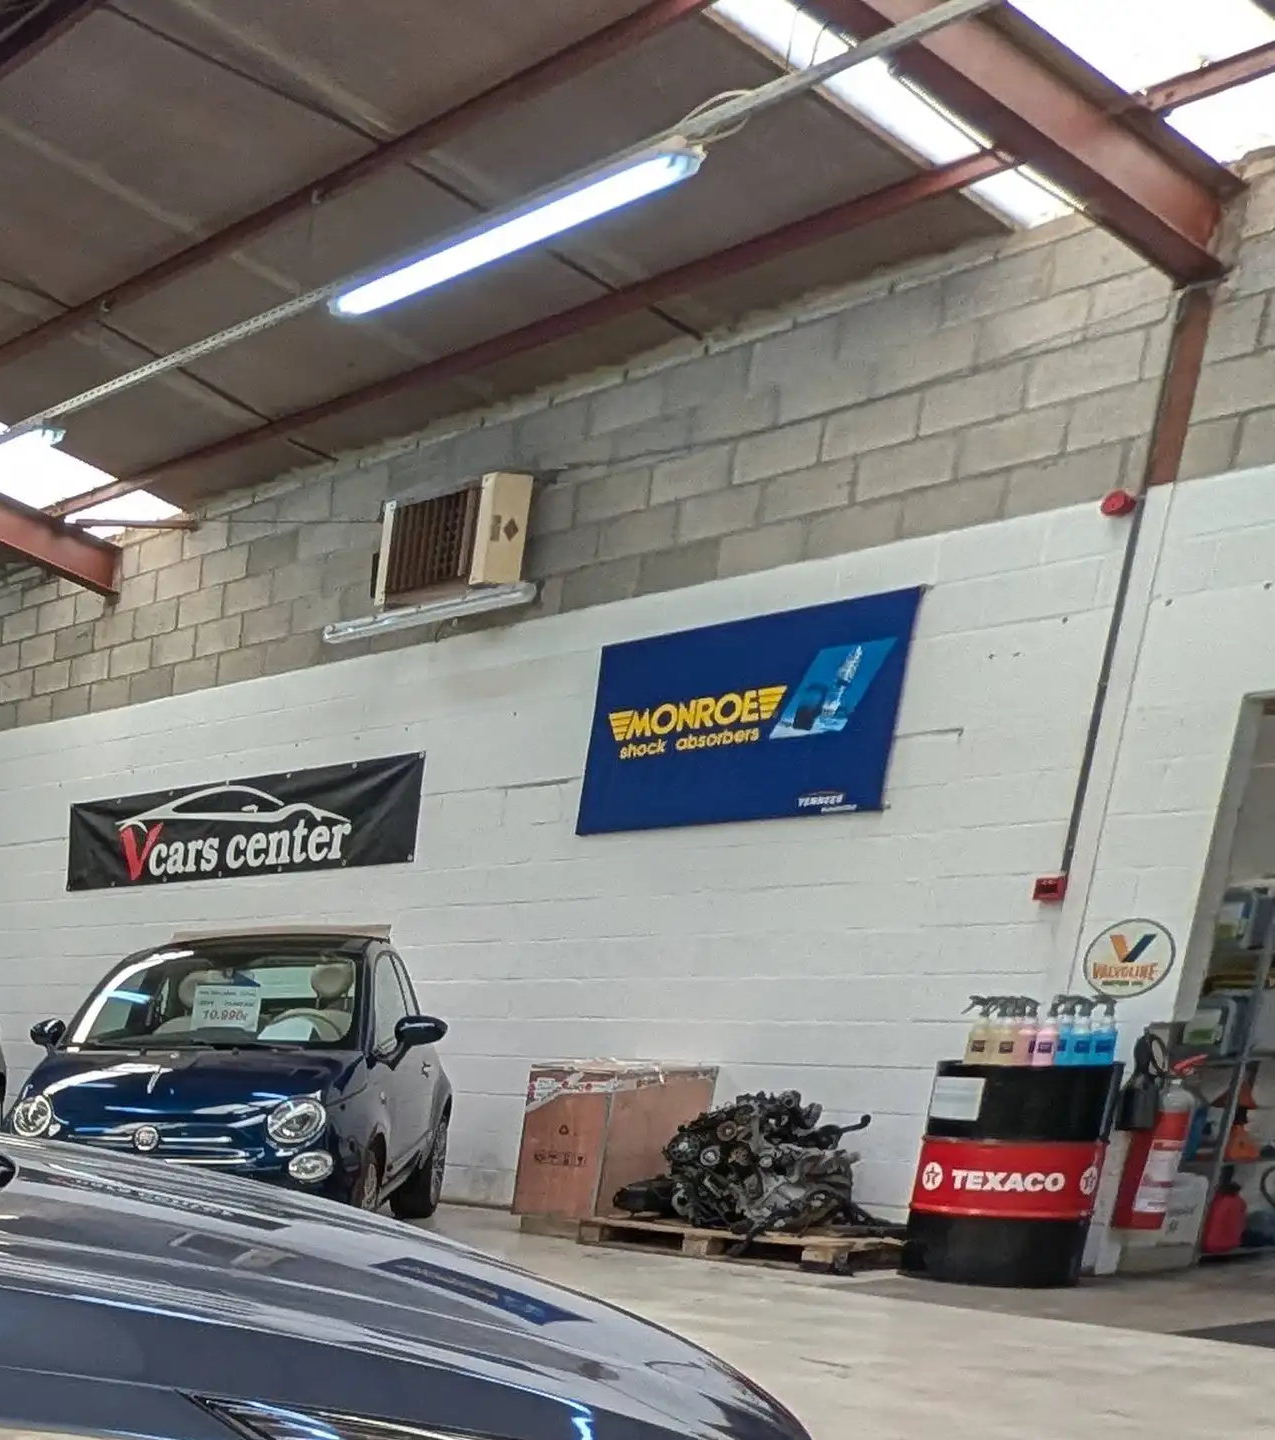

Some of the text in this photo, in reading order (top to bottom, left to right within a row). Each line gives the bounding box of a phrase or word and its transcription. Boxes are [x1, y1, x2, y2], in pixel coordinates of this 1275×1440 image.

[623, 689, 760, 741] MONROE
[619, 728, 760, 760] shock absorbers
[226, 818, 352, 870] center
[1093, 962, 1159, 981] VALVOLINE
[952, 1169, 1066, 1193] TEXACO
